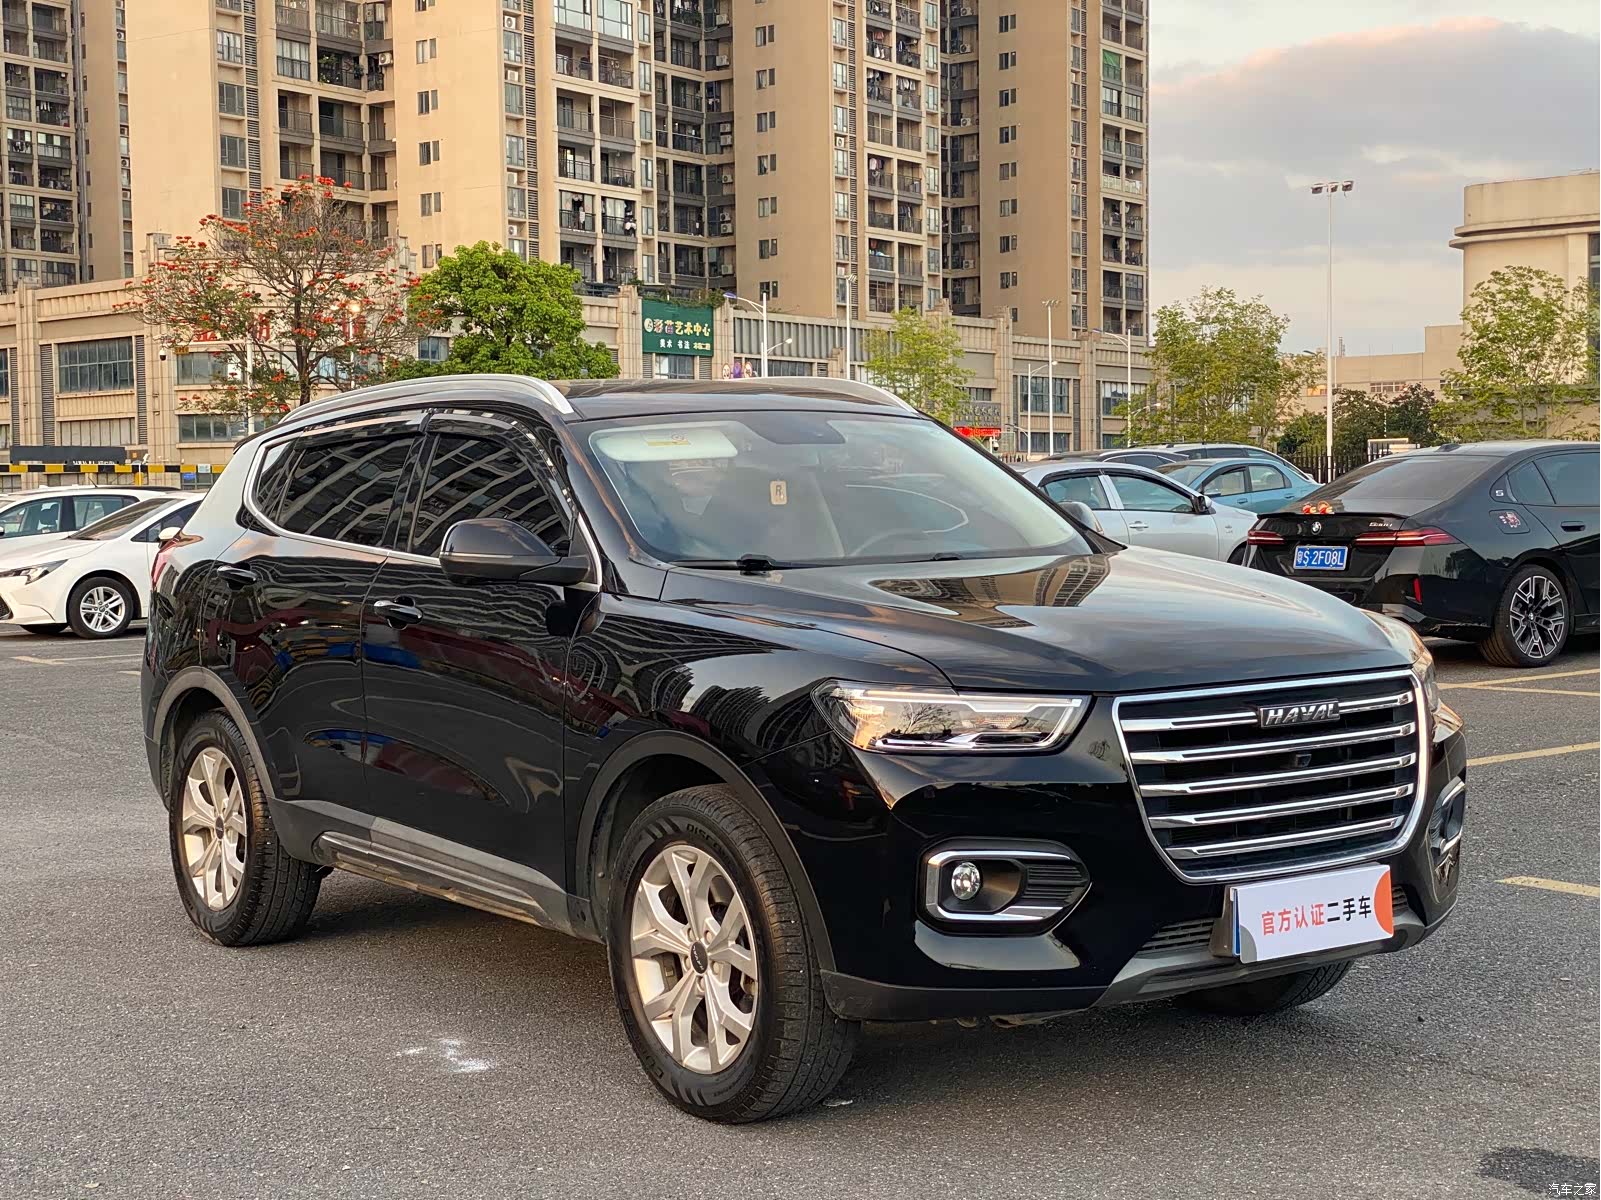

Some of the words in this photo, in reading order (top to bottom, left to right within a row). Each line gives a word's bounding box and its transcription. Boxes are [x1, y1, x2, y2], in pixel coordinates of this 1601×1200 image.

[1265, 703, 1340, 726] HAVAL
[1261, 895, 1372, 936] 官方认证二手车
